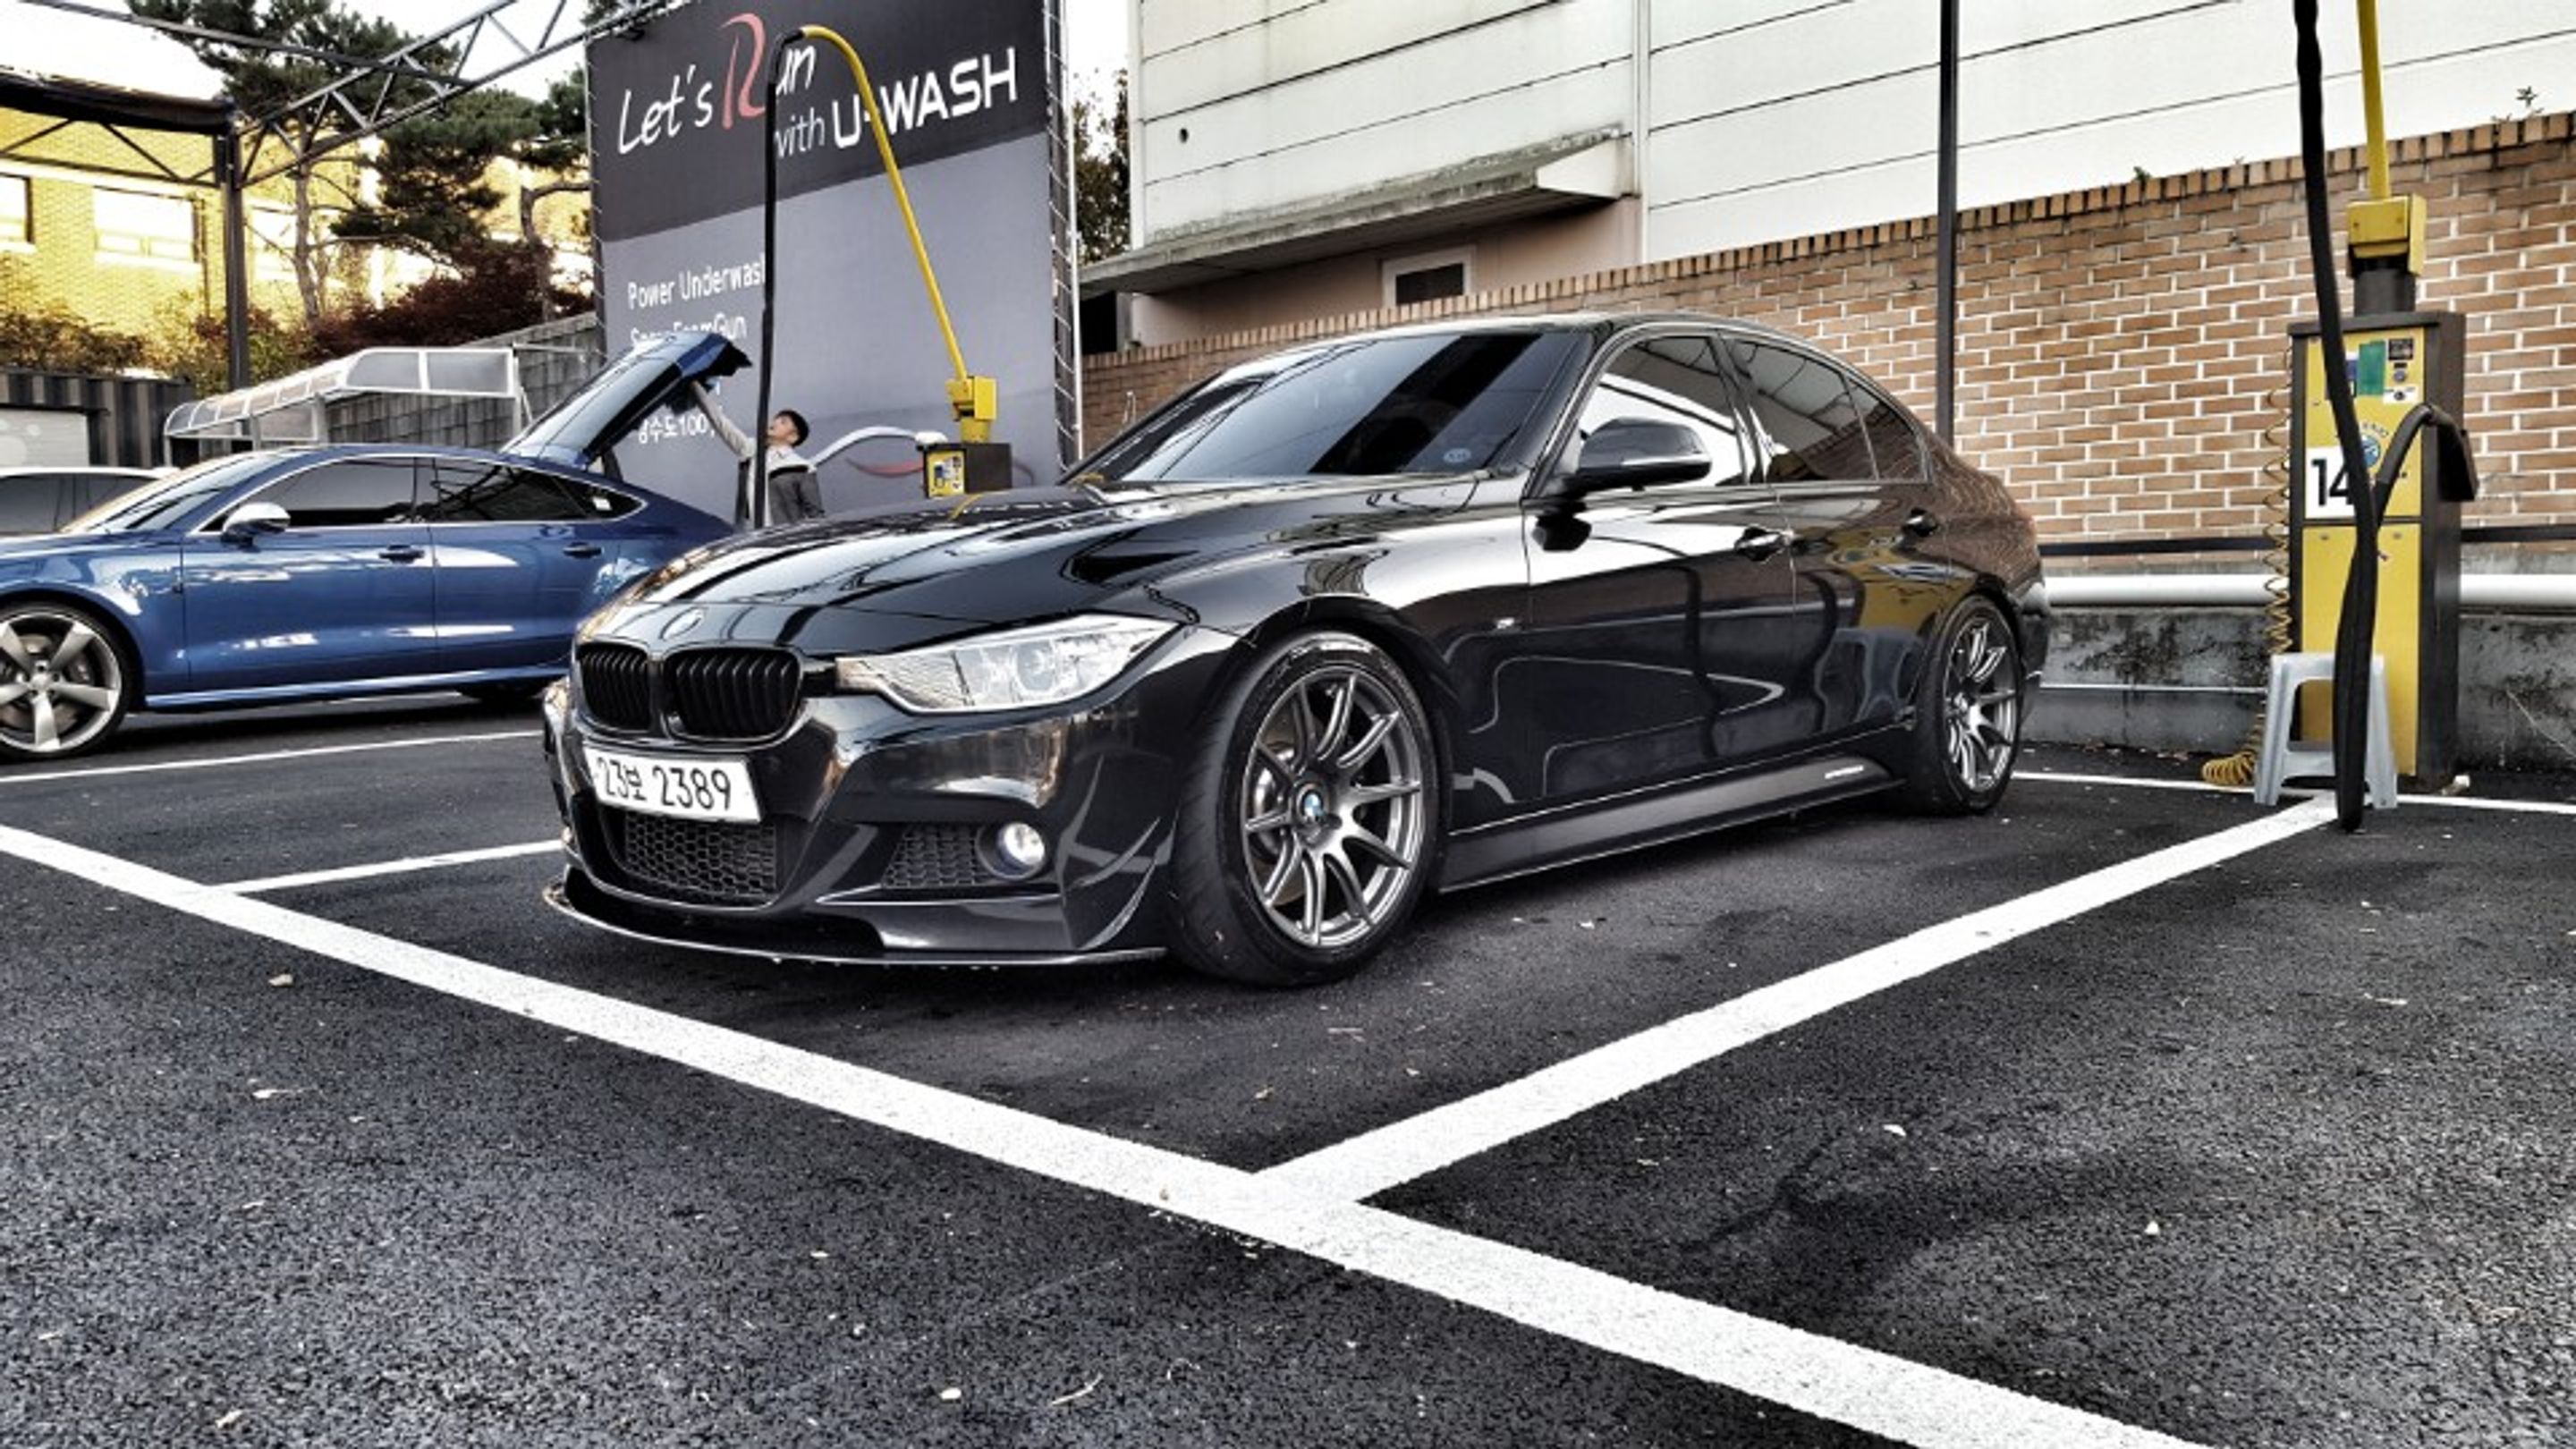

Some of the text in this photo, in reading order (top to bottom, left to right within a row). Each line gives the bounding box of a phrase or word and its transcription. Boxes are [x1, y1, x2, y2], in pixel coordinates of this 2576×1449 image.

[617, 64, 714, 155] Let's
[832, 47, 1018, 149] U-WASH
[628, 280, 675, 310] Power
[2311, 457, 2355, 506] 14
[652, 765, 732, 811] 2389
